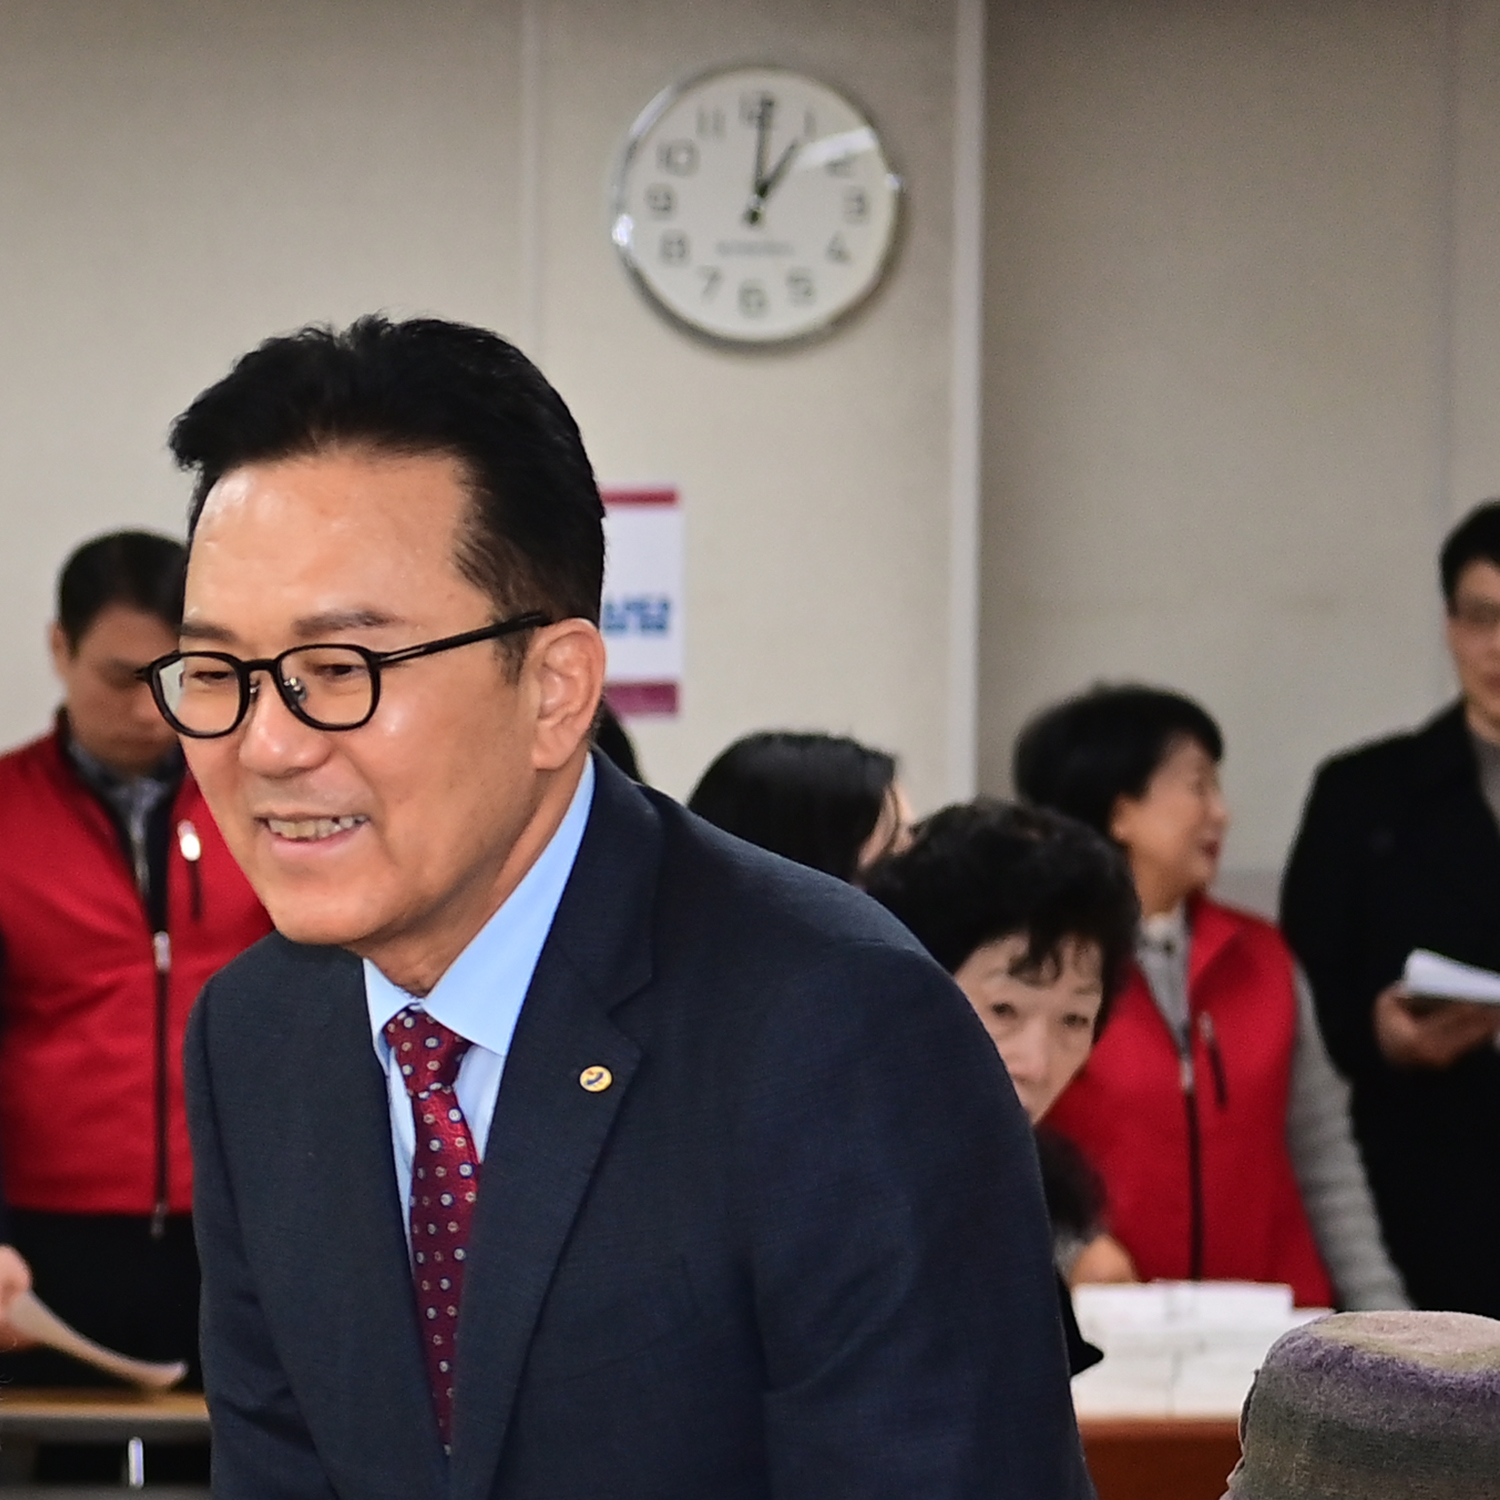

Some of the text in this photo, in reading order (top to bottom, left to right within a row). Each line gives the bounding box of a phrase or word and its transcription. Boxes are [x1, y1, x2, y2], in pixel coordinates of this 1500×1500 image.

[657, 140, 697, 176] 10
[825, 232, 850, 264] 4
[698, 265, 722, 298] 7
